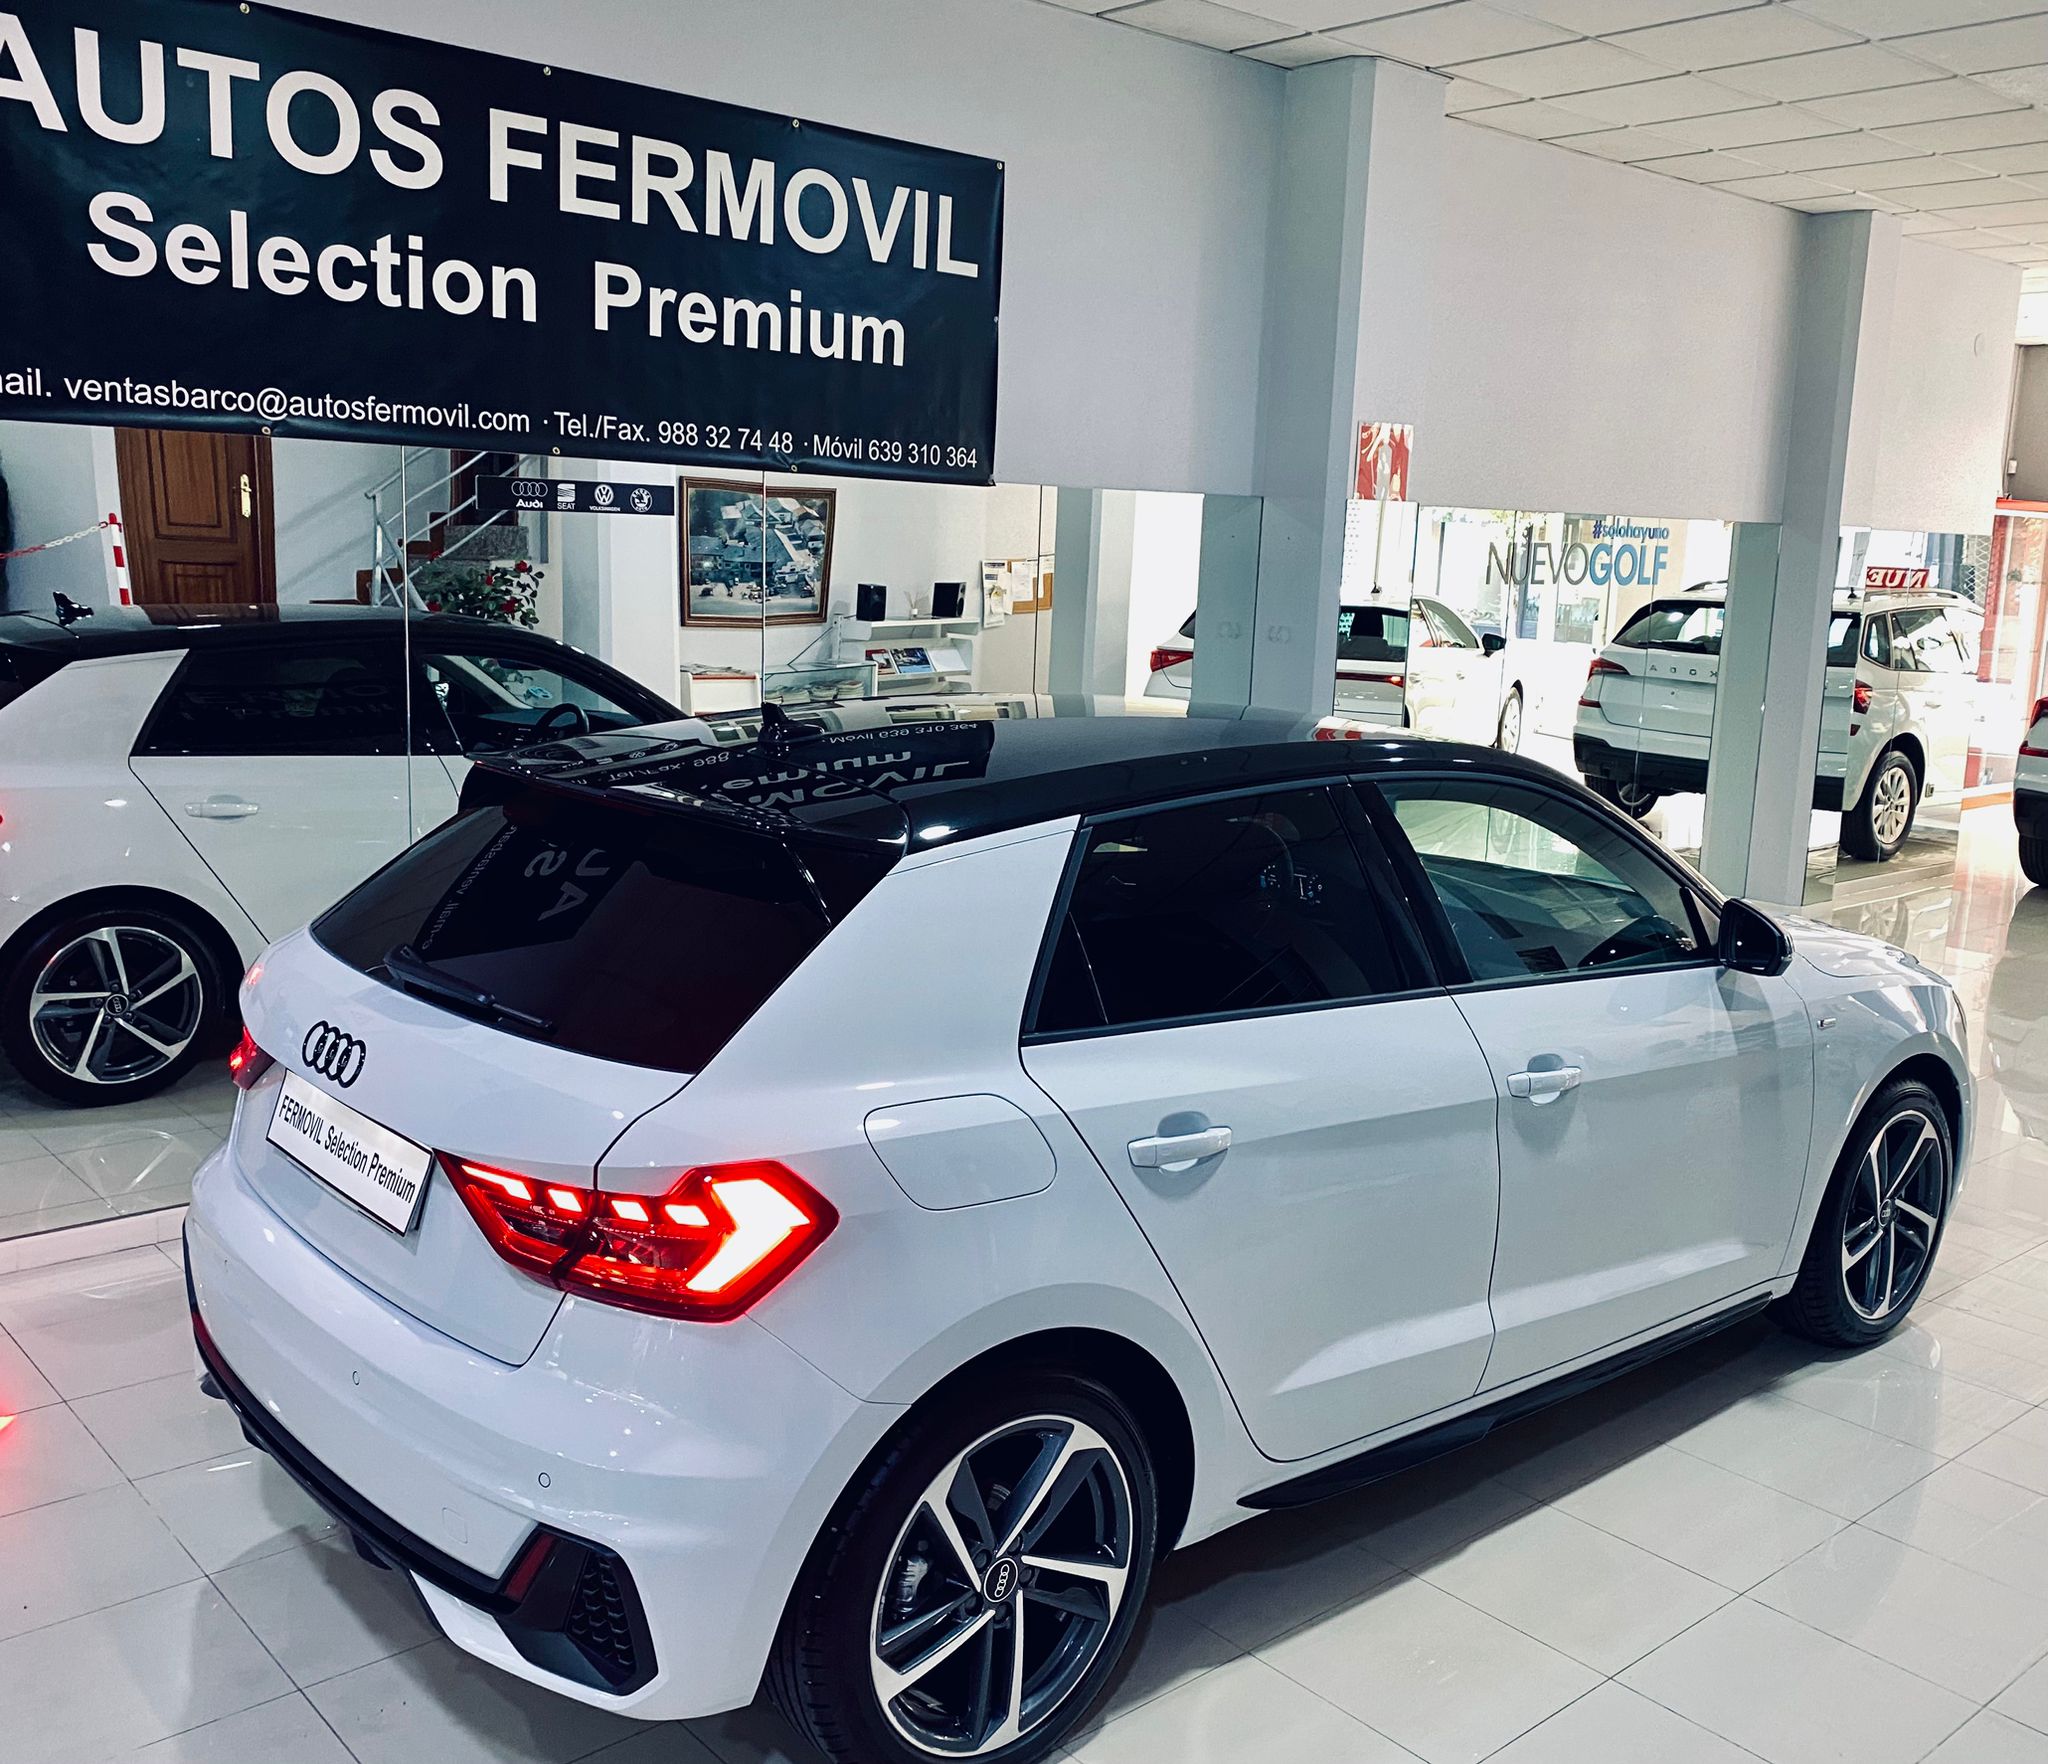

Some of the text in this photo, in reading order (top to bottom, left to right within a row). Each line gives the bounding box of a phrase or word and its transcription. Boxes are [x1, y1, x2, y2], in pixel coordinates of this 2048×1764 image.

[490, 108, 978, 278] FERMOVIL
[87, 191, 906, 367] Selection Premium
[0, 368, 977, 468] ail. ventasbarco@autosfermovil.com Tel./Fax. 988 32 74 48 Móvil 639 310 364
[516, 498, 543, 509] Audi
[557, 502, 575, 510] SEAT
[279, 1095, 416, 1204] FERMOVIL Selection Premium
